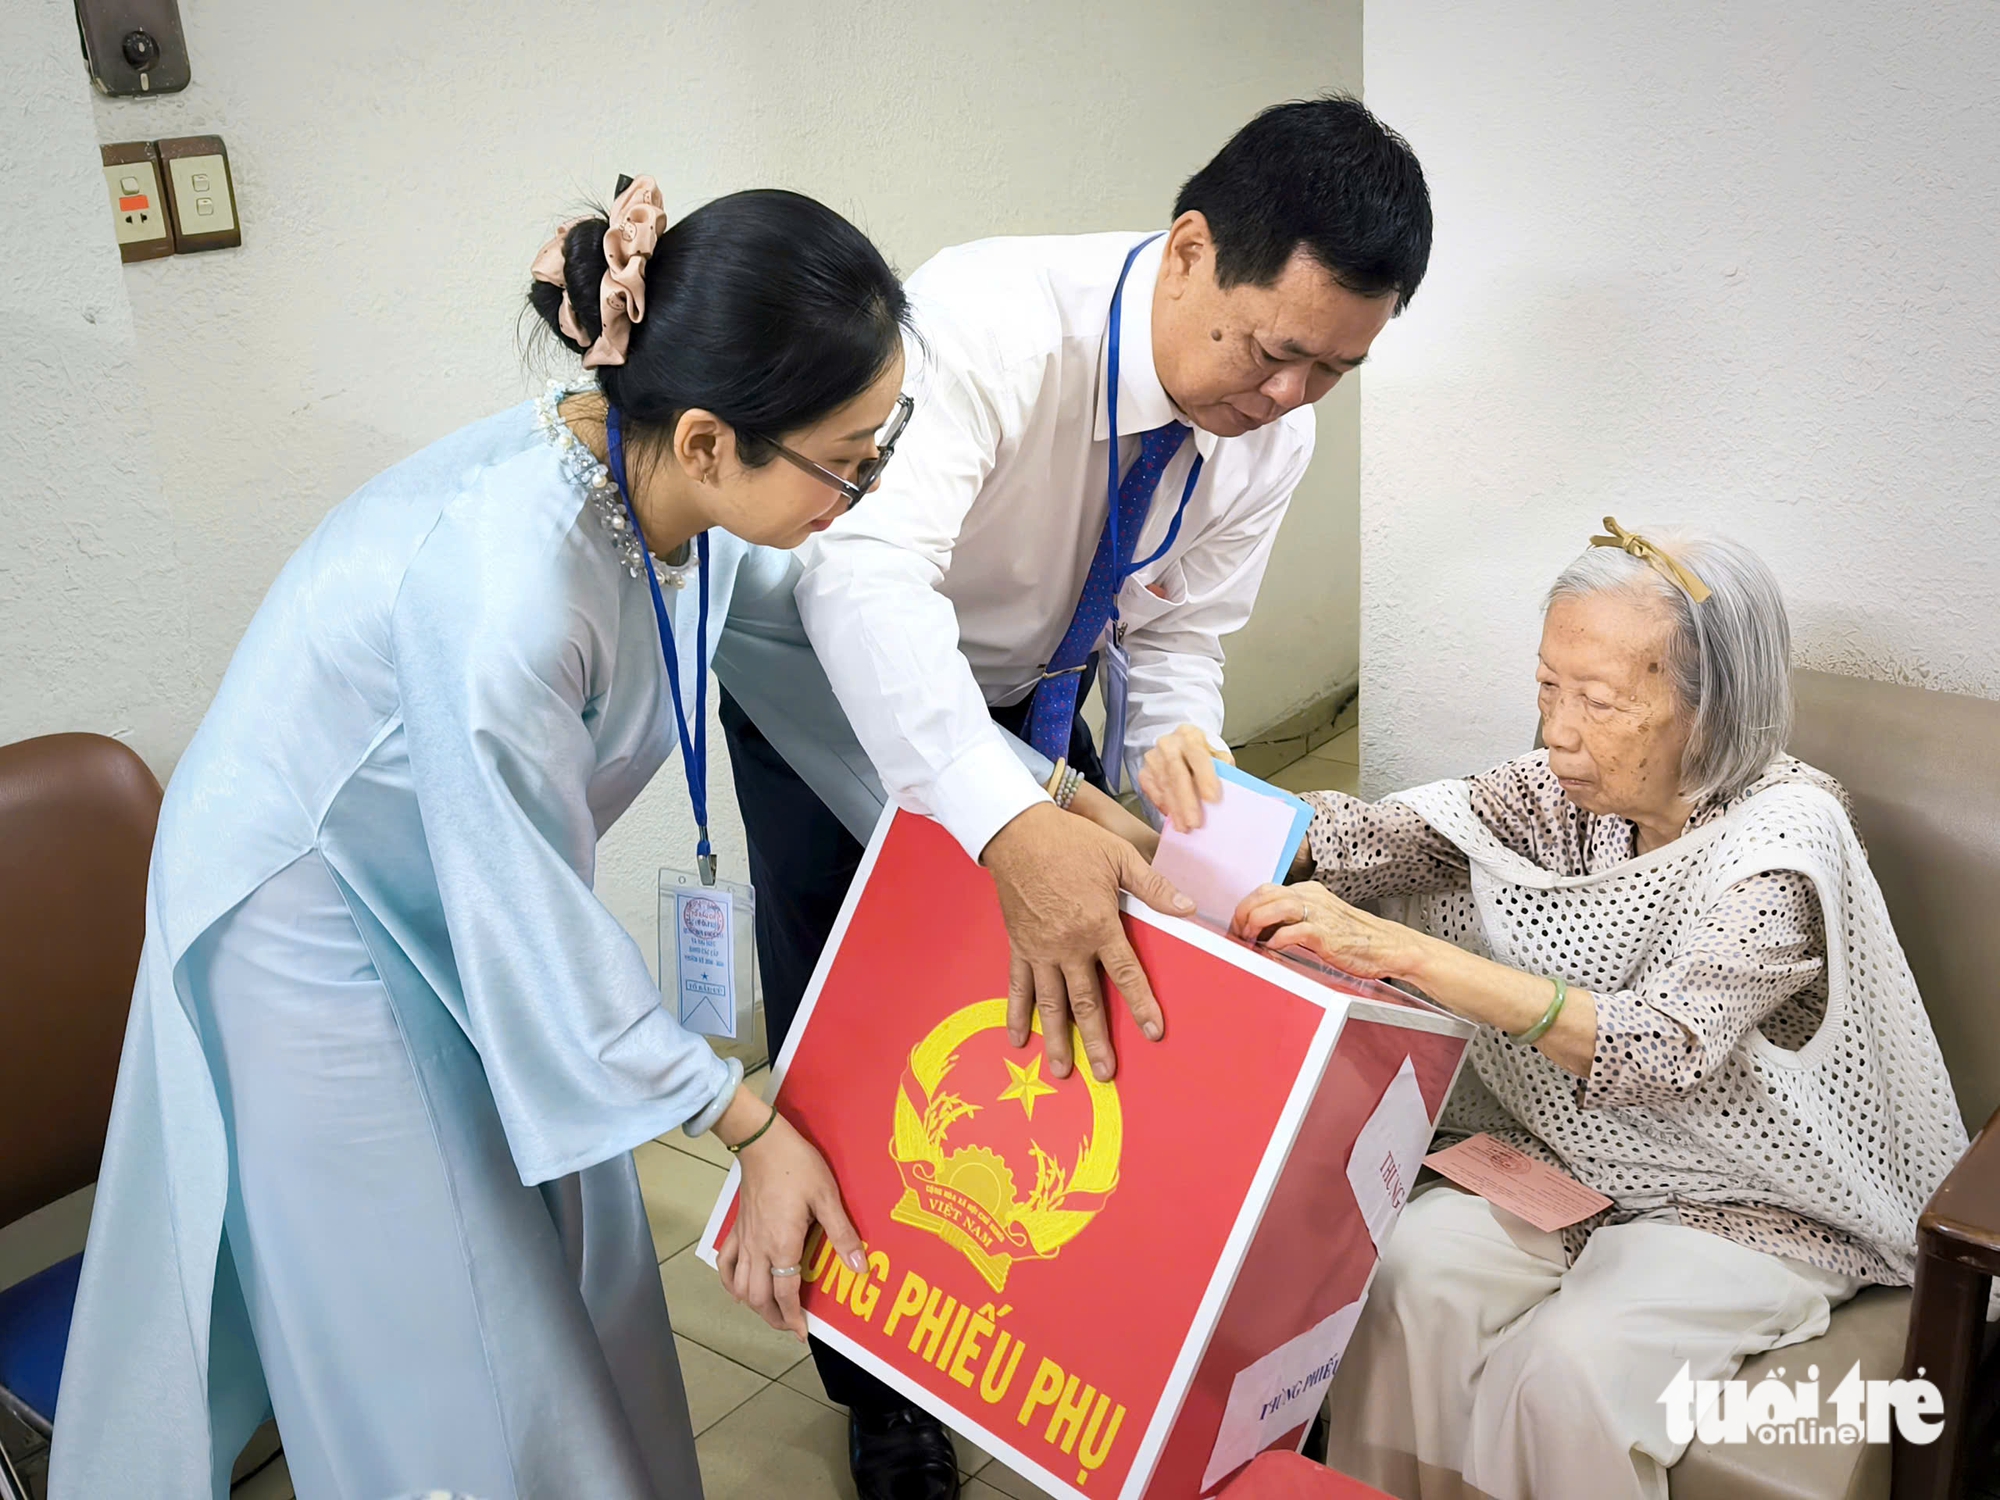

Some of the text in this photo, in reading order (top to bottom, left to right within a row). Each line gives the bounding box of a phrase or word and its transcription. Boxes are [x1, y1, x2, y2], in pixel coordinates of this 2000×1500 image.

[929, 1198, 963, 1221] VIỆT
[962, 1216, 994, 1248] NAM
[883, 1270, 1026, 1404] PHIẾU
[1016, 1356, 1127, 1486] PHỤ
